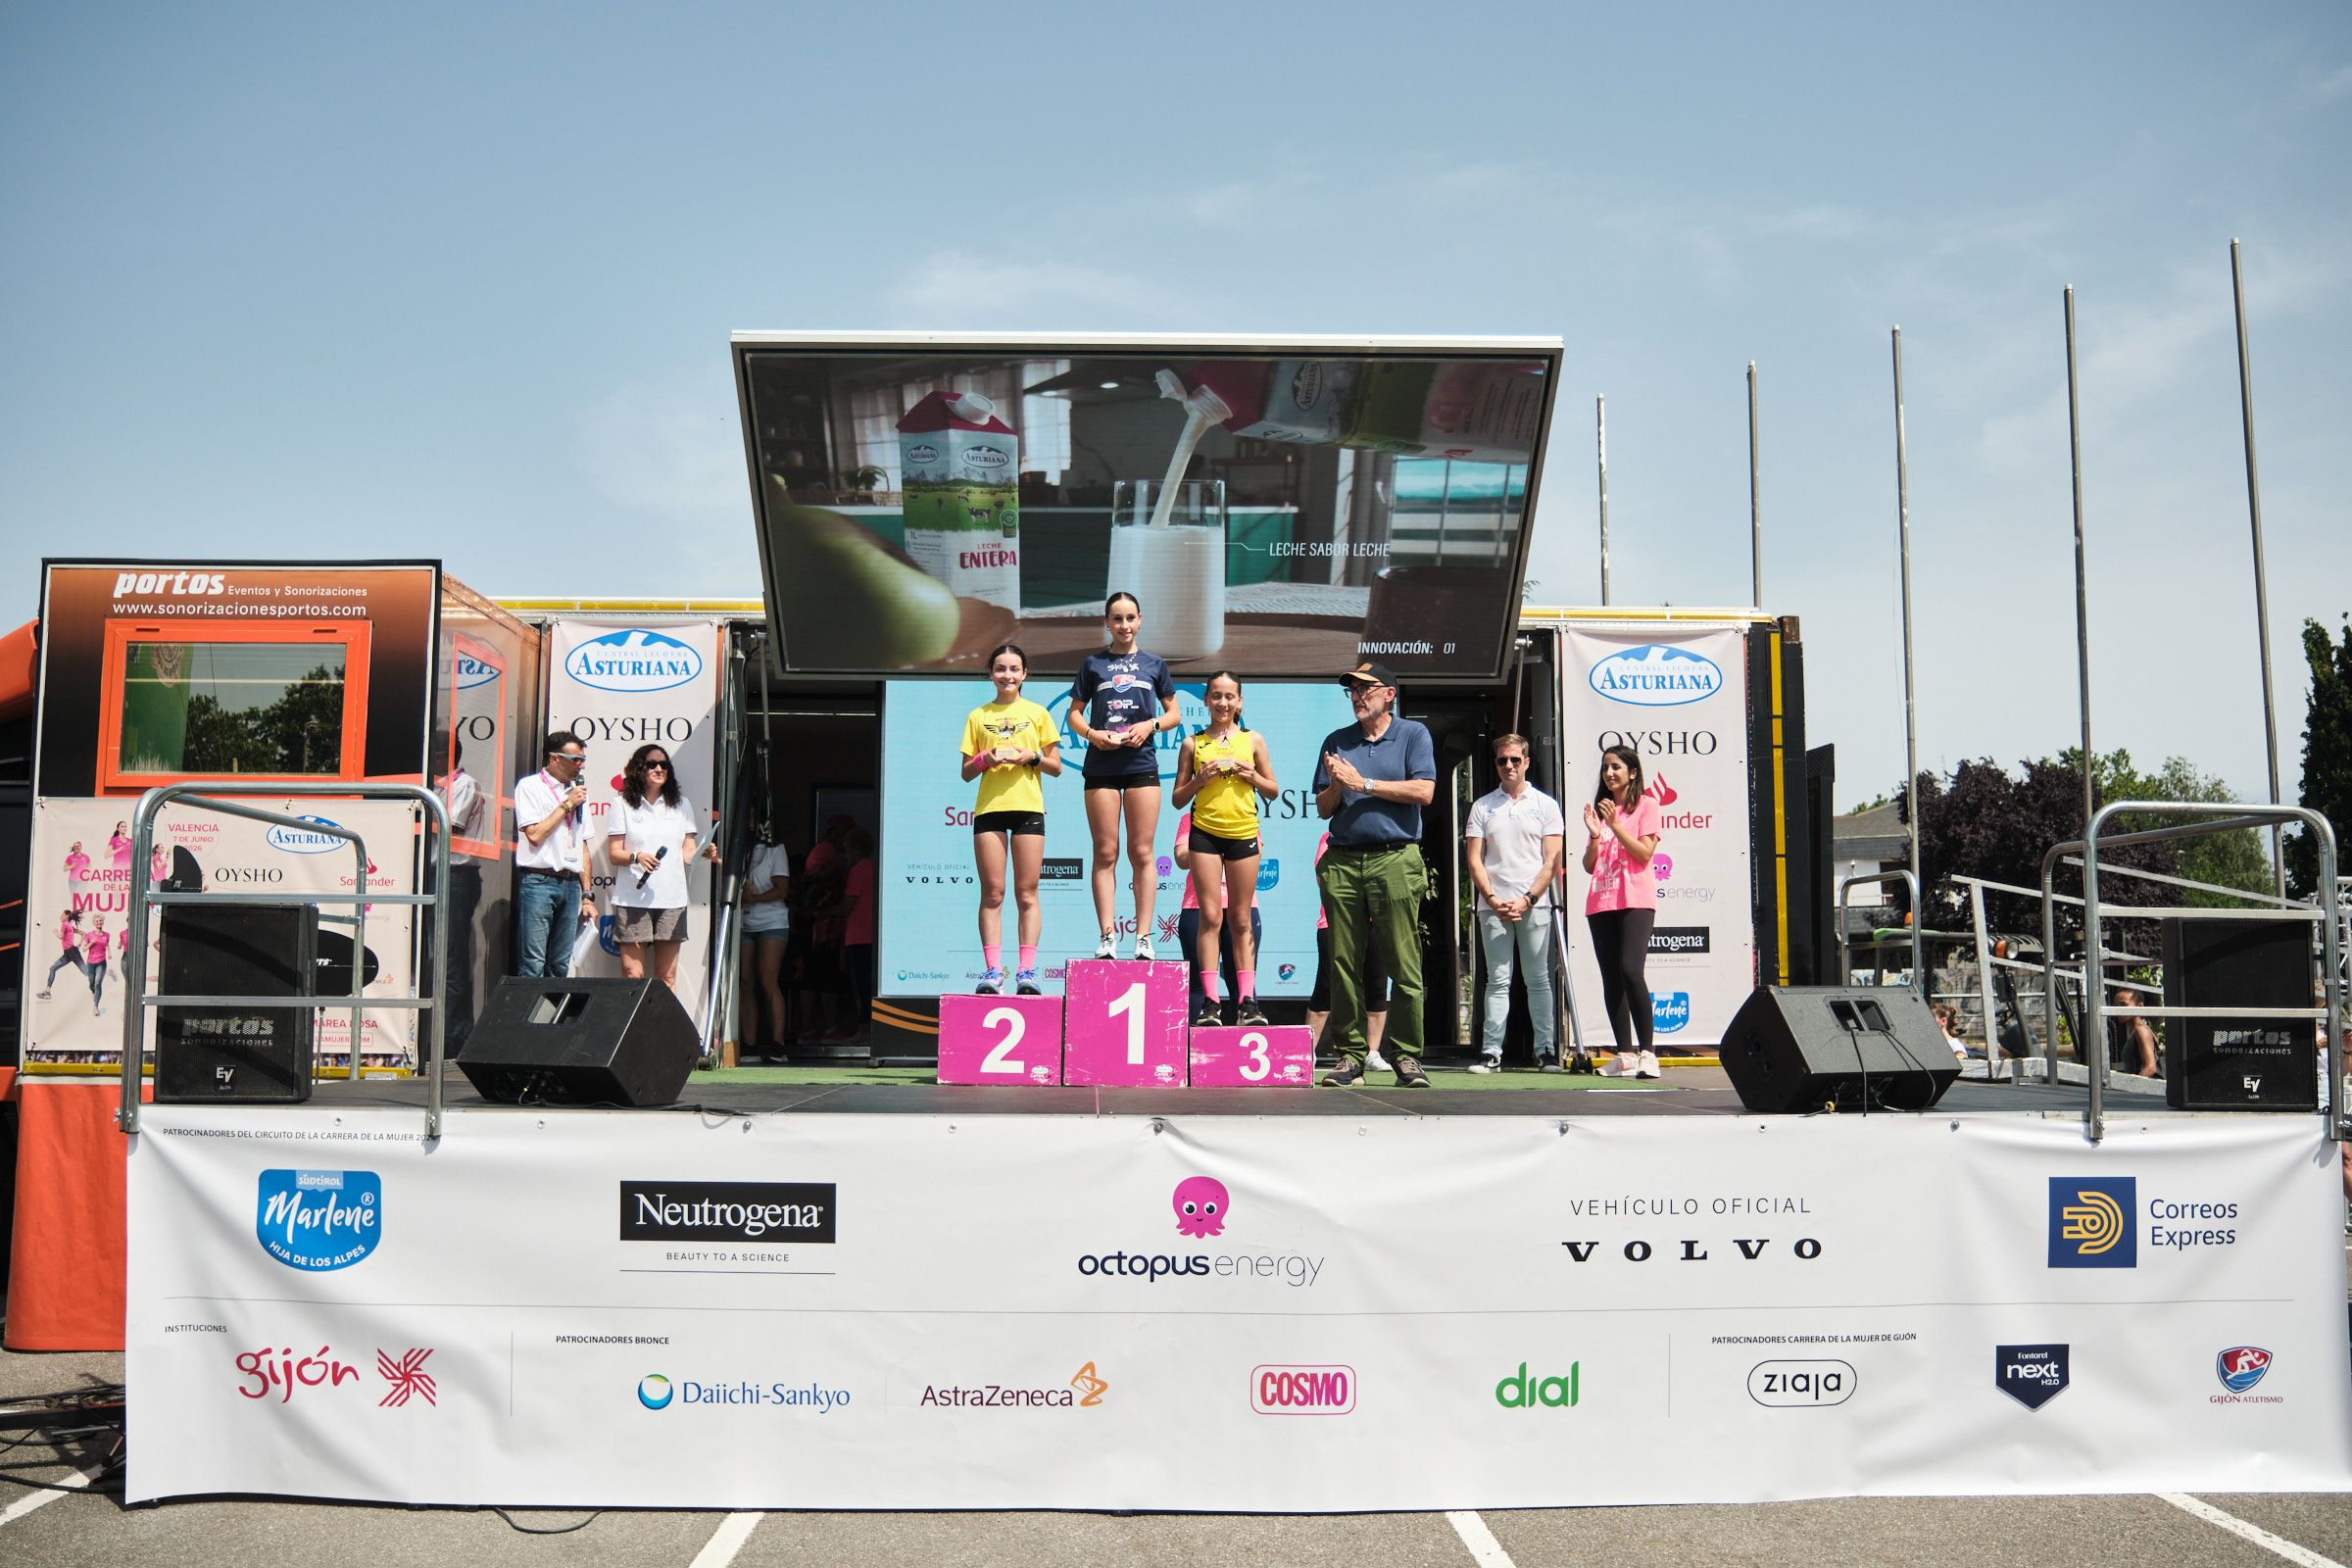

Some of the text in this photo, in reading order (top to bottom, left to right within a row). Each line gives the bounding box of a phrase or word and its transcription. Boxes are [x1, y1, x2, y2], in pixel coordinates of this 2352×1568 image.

[965, 453, 1005, 464] ASTURIANA
[959, 551, 1017, 568] ENTERA
[1269, 543, 1390, 557] LECHE SABOR LECHE
[114, 571, 368, 598] portos Eventos y Sonorizaciones
[113, 602, 367, 617] www.sonorizacionesportos.com
[1357, 640, 1455, 655] INNOVACIÓN: 01
[574, 653, 691, 676] ASTURIANA
[1600, 666, 1713, 690] ASTURIANA
[570, 717, 693, 742] OYSHO
[169, 823, 220, 832] VALENCIA
[216, 868, 283, 883] OYSHO
[1041, 864, 1078, 878] trogena
[339, 876, 396, 887] Sanander
[73, 893, 130, 912] MUJ
[1667, 886, 1716, 902] energy
[1647, 933, 1702, 951] trogena
[1107, 982, 1147, 1065] 1
[979, 1006, 1026, 1074] 2
[2213, 1029, 2291, 1047] portos
[1238, 1032, 1271, 1081] 3
[163, 1128, 235, 1139] PATROCINADORES
[321, 1132, 359, 1141] CARRERA
[634, 1193, 822, 1236] Neutrogena
[1570, 1196, 1811, 1215] VEHÍCULO OFICIAL
[2150, 1199, 2237, 1219] Correos
[265, 1191, 374, 1245] Marlene
[2151, 1226, 2236, 1250] Express
[270, 1241, 366, 1267] HIJA DE LOS ALPES
[713, 1252, 727, 1261] TO
[731, 1252, 738, 1261] A
[742, 1253, 790, 1262] SCIENCE
[1561, 1238, 1822, 1262] VOLVO
[165, 1324, 227, 1333] INSTITUCIONES
[556, 1336, 633, 1345] PATROCINADORES
[1711, 1335, 1787, 1345] PATROCINADORES
[1788, 1335, 1827, 1345] CARRERA
[1882, 1334, 1891, 1343] DE
[1893, 1332, 1917, 1342] GIJÓN
[235, 1345, 360, 1403] gijón
[2007, 1361, 2060, 1379] next
[1259, 1372, 1348, 1407] COSMO
[1495, 1360, 1580, 1408] dial
[1763, 1372, 1841, 1400] ziaja
[682, 1382, 851, 1414] Daiichi-Sankyo
[920, 1385, 1073, 1407] AstraZeneca
[2209, 1394, 2240, 1403] GIJÓN
